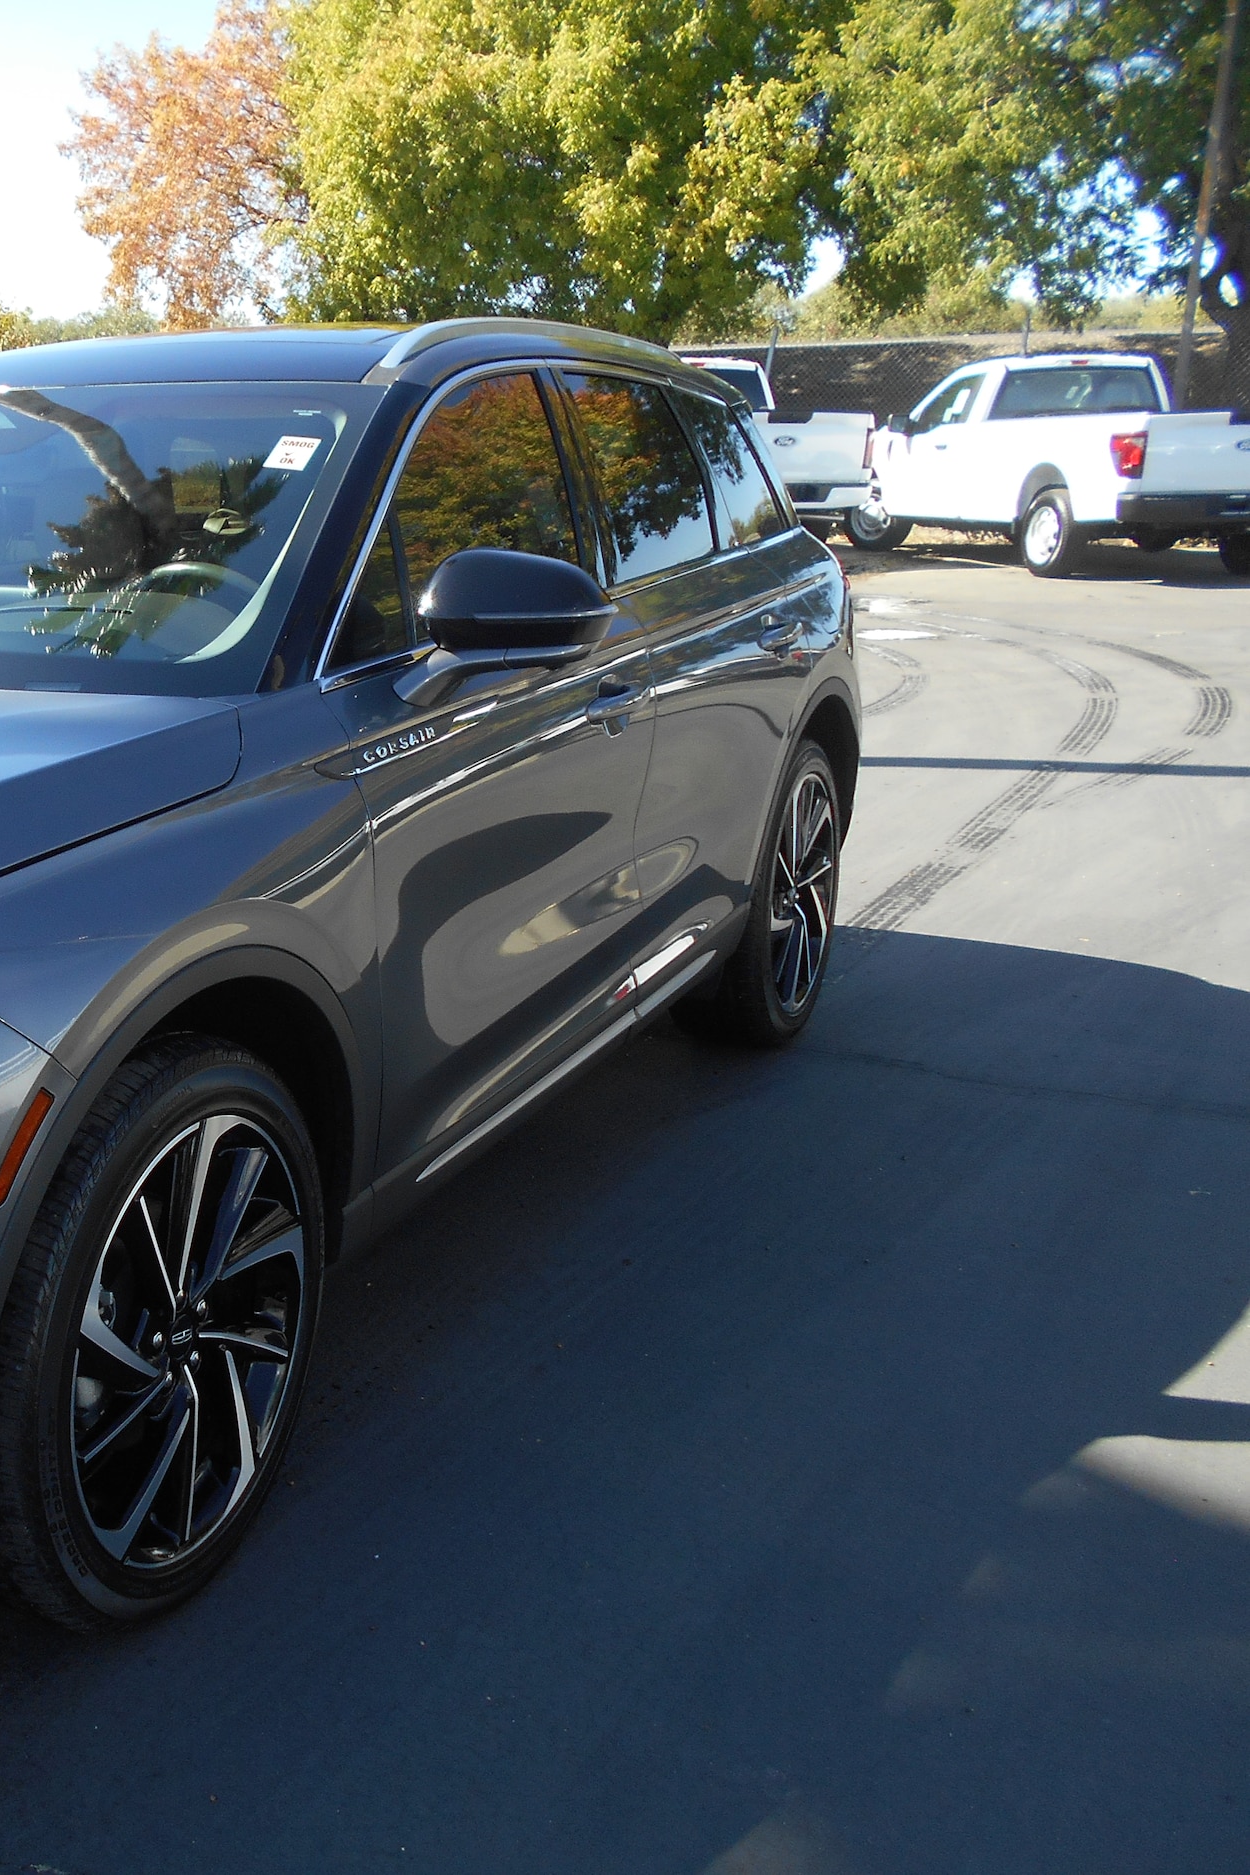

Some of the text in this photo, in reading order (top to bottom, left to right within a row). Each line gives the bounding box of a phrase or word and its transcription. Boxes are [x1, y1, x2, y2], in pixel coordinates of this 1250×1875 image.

[281, 440, 315, 448] SMOG
[280, 457, 296, 465] OK
[363, 726, 436, 763] CORSAIR
